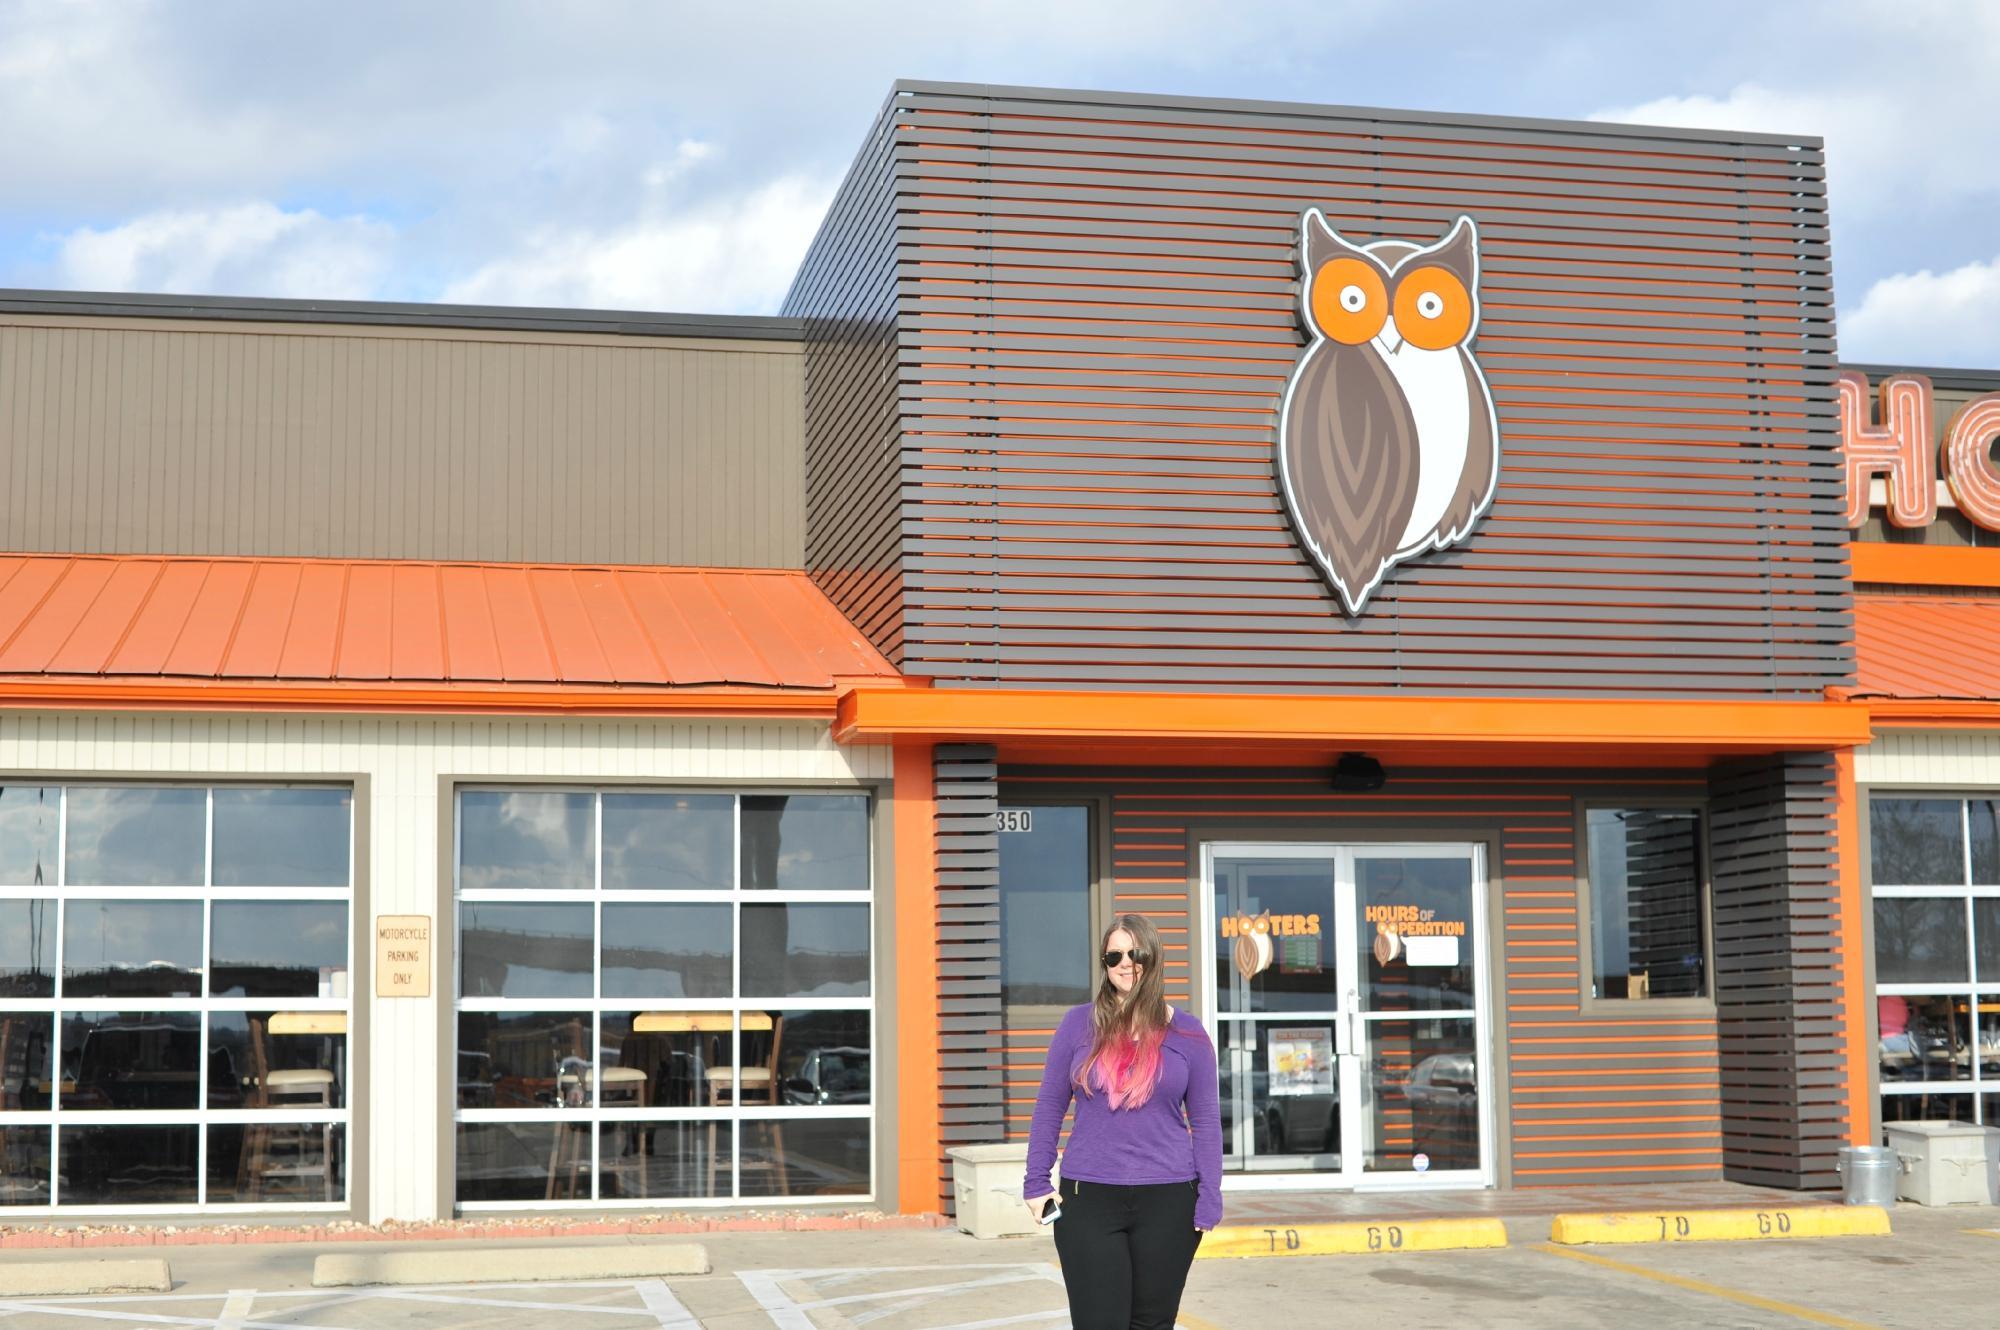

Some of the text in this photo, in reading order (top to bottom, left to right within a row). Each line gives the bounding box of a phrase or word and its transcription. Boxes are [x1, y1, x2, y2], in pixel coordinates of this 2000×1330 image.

[996, 811, 1030, 831] 350
[1365, 905, 1435, 922] HOURS OF
[379, 928, 427, 940] MOTORCYCLE
[1221, 914, 1320, 938] HOOTERS
[387, 951, 419, 962] PARKING
[393, 972, 412, 984] ONLY
[1656, 1213, 1790, 1240] TO GO
[1264, 1226, 1403, 1252] TO GO
